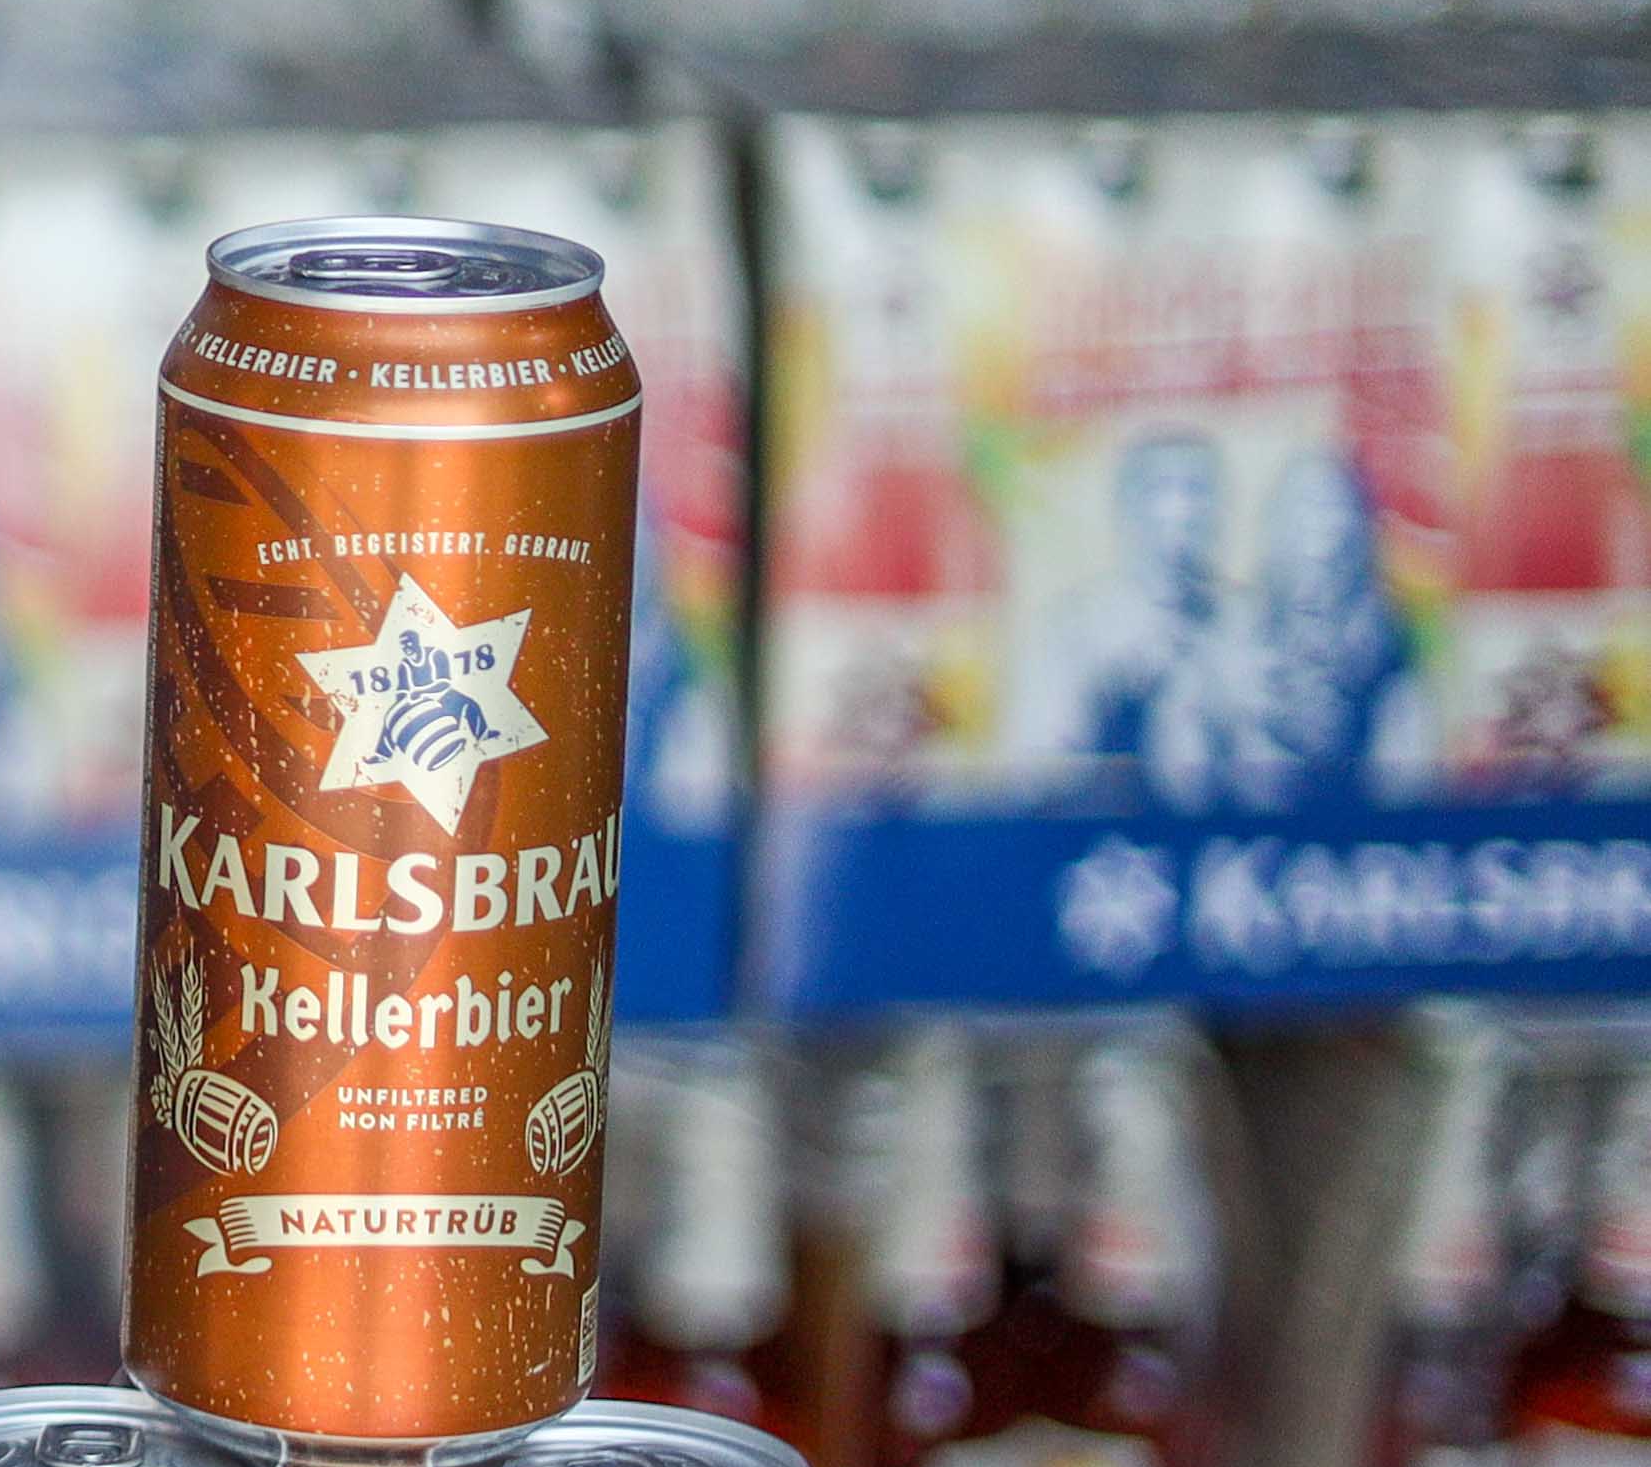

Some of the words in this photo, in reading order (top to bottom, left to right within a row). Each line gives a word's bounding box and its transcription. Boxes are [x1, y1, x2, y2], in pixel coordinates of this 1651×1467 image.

[371, 360, 552, 390] KELLERBIER
[257, 538, 320, 565] ECHT.
[335, 532, 490, 558] BEGEISTERT.
[505, 533, 590, 565] GEBRAUT.
[241, 963, 573, 1049] Kellerbier
[338, 1086, 488, 1105] UNFILTERED
[340, 1110, 397, 1129] NON
[407, 1107, 484, 1129] FILTRÉ
[281, 1201, 519, 1235] NATURTRÜB
